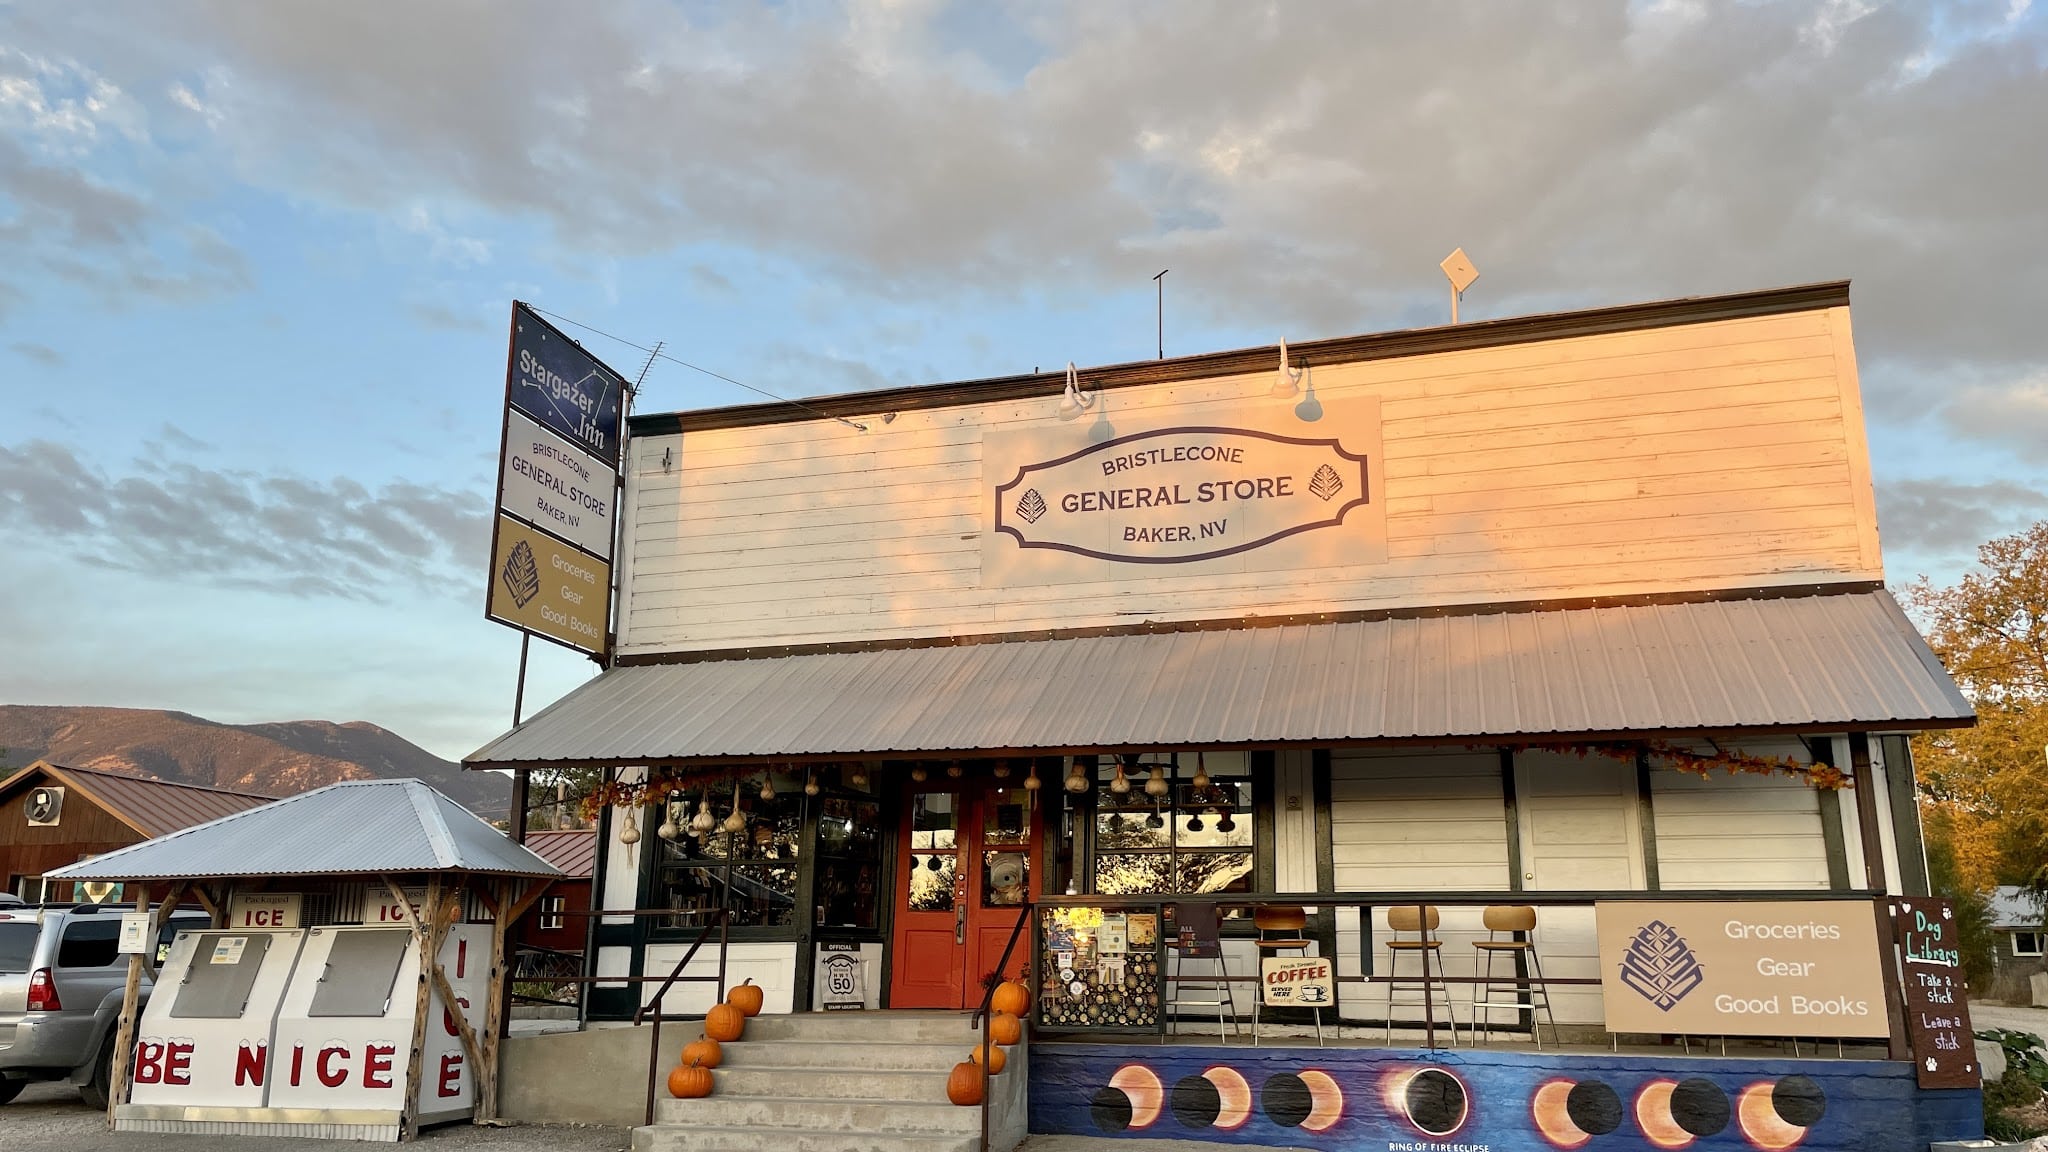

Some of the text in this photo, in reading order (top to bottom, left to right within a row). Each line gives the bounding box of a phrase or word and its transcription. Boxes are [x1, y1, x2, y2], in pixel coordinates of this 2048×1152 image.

[519, 349, 593, 414] Stargazer
[578, 412, 605, 450] Inn
[532, 442, 590, 483] BRISTLECONE
[1101, 446, 1244, 476] BRISTLECONE
[512, 455, 606, 517] GENERAL STORE
[1061, 476, 1294, 513] GENERAL STORE
[568, 514, 580, 527] NV
[1123, 518, 1227, 542] BAKER, NV
[551, 553, 595, 584] Groceries
[561, 585, 584, 605] Gear
[540, 604, 598, 639] Good Books
[245, 909, 284, 926] ICE
[1915, 910, 1942, 941] Dog
[1724, 920, 1840, 940] Groceries
[1906, 931, 1959, 967] Library
[1267, 966, 1327, 985] COFFEE
[1757, 957, 1815, 976] Gear
[833, 978, 850, 990] 50
[1916, 973, 1952, 987] Take a
[1715, 994, 1868, 1015] Good Books
[1921, 1012, 1961, 1028] Leave a
[134, 1036, 195, 1085] BE
[1389, 1142, 1489, 1152] RING OF FIRE ECLIPSE
